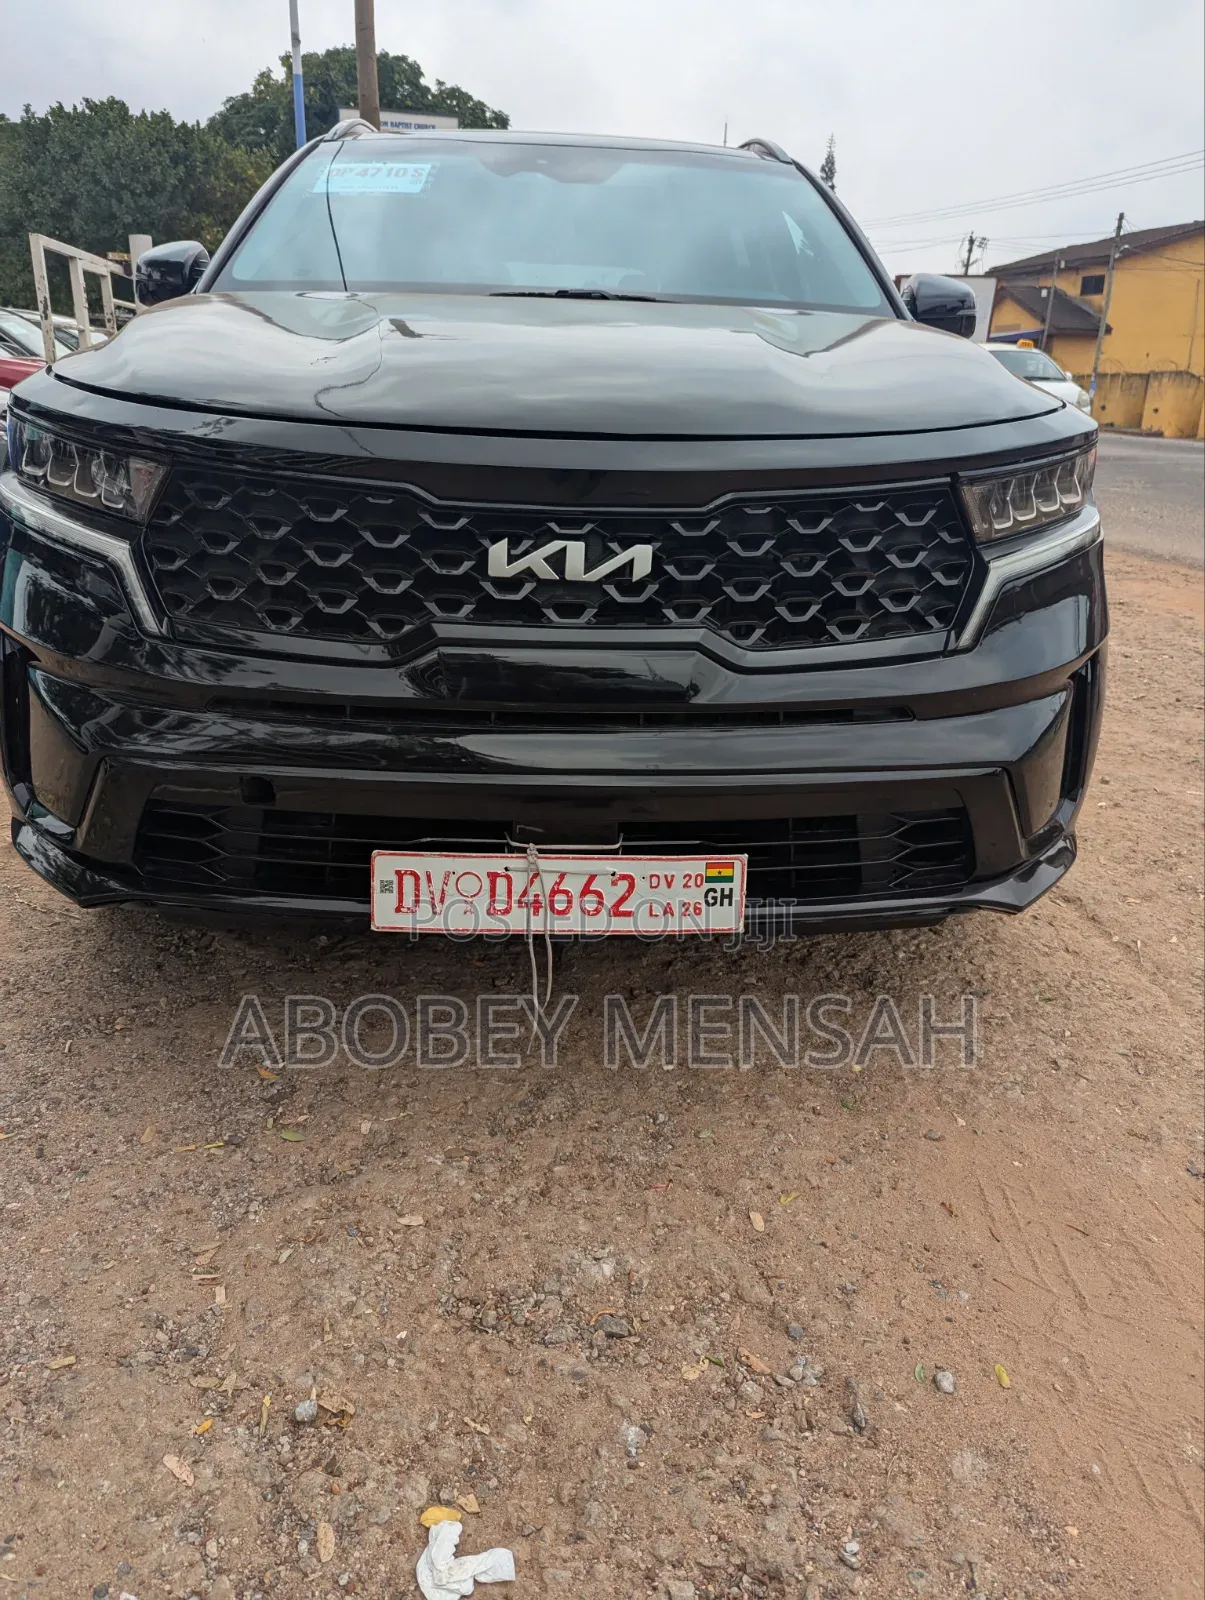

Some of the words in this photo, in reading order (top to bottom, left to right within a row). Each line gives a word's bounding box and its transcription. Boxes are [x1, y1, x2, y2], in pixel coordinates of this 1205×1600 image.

[390, 121, 412, 129] BAPTIST
[355, 167, 409, 178] 4710
[411, 167, 425, 178] S
[488, 537, 653, 582] KIA
[649, 873, 676, 889] DV
[682, 873, 705, 889] 20
[394, 869, 452, 916] DV
[703, 887, 734, 908] GH
[649, 901, 675, 917] LA
[681, 901, 704, 917] 26
